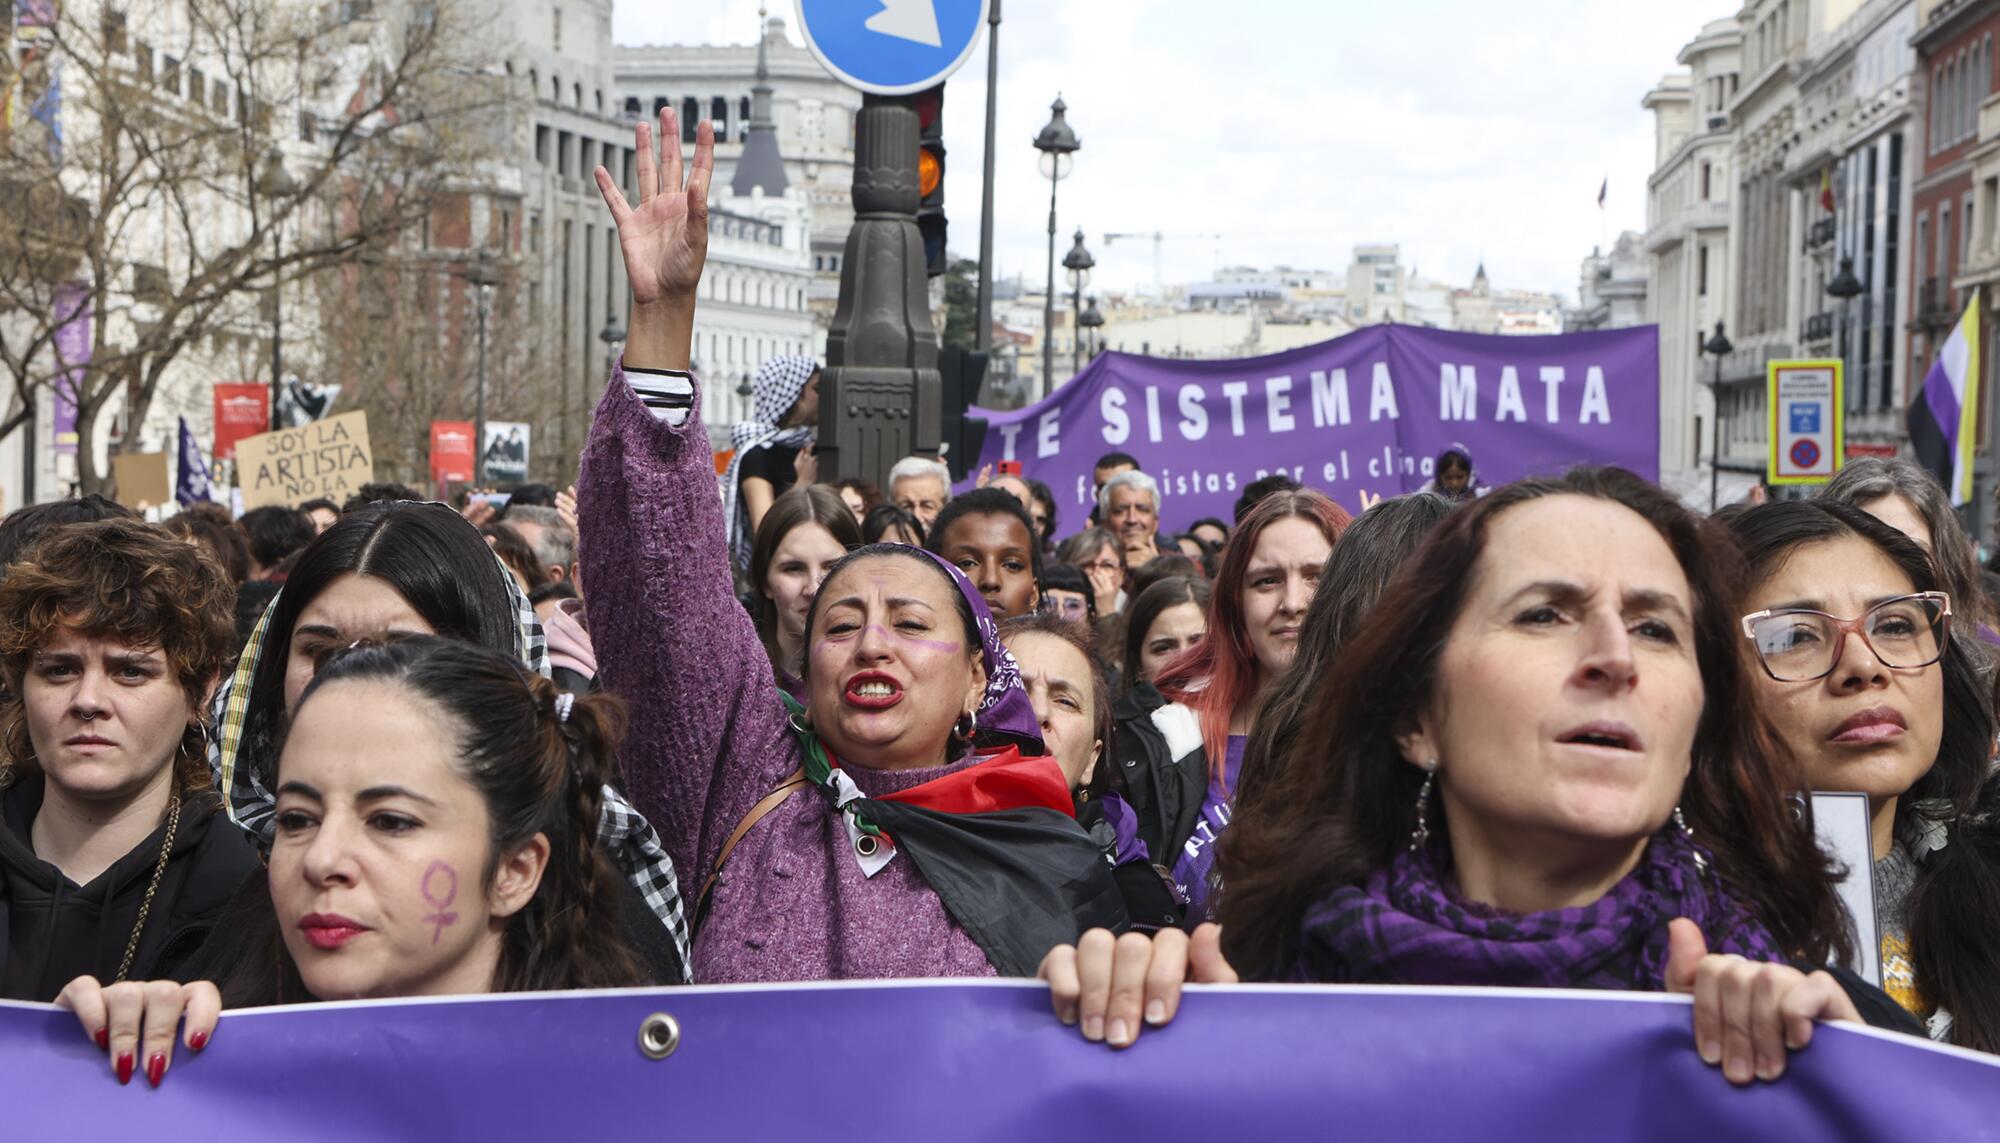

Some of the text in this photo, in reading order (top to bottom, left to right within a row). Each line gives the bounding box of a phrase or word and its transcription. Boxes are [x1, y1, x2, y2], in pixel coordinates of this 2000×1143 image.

[1101, 362, 1399, 445] SISTEMA
[1440, 363, 1611, 424] MATA
[266, 429, 308, 455] SOY
[317, 421, 349, 445] LA
[255, 444, 368, 489] ARTISTA
[286, 475, 348, 499] NO LA
[1076, 468, 1236, 505] fistas
[1323, 450, 1350, 482] el
